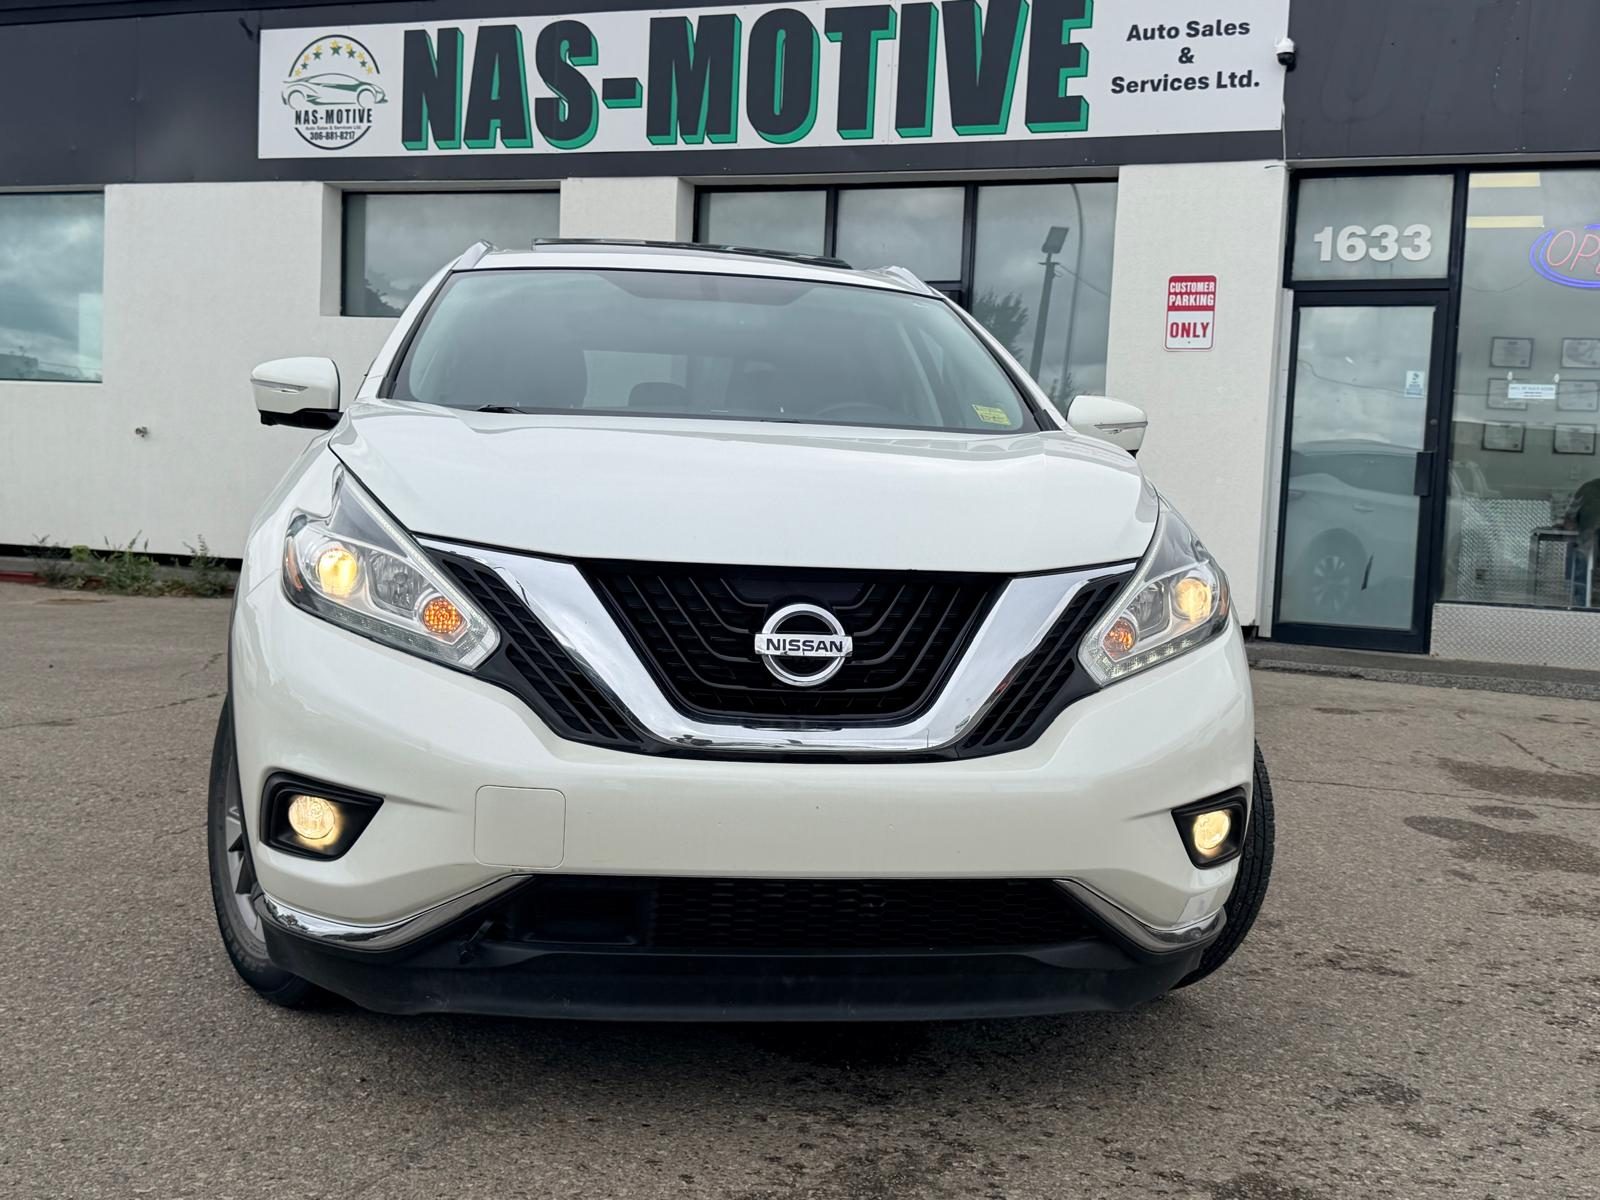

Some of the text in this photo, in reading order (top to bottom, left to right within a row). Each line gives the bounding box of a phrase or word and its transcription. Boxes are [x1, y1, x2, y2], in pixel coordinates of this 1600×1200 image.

[1126, 19, 1251, 42] Auto Sales
[1178, 46, 1195, 64] &
[401, 0, 1094, 151] NAS-MOTIVE
[1111, 69, 1260, 94] Services Ltd.
[295, 108, 372, 125] NAS-MOTIVE
[1313, 223, 1432, 262] 1633
[1169, 281, 1215, 293] CUSTOMER
[1168, 294, 1214, 306] PARKING
[1170, 322, 1210, 338] ONLY
[766, 638, 843, 653] NISSAN
